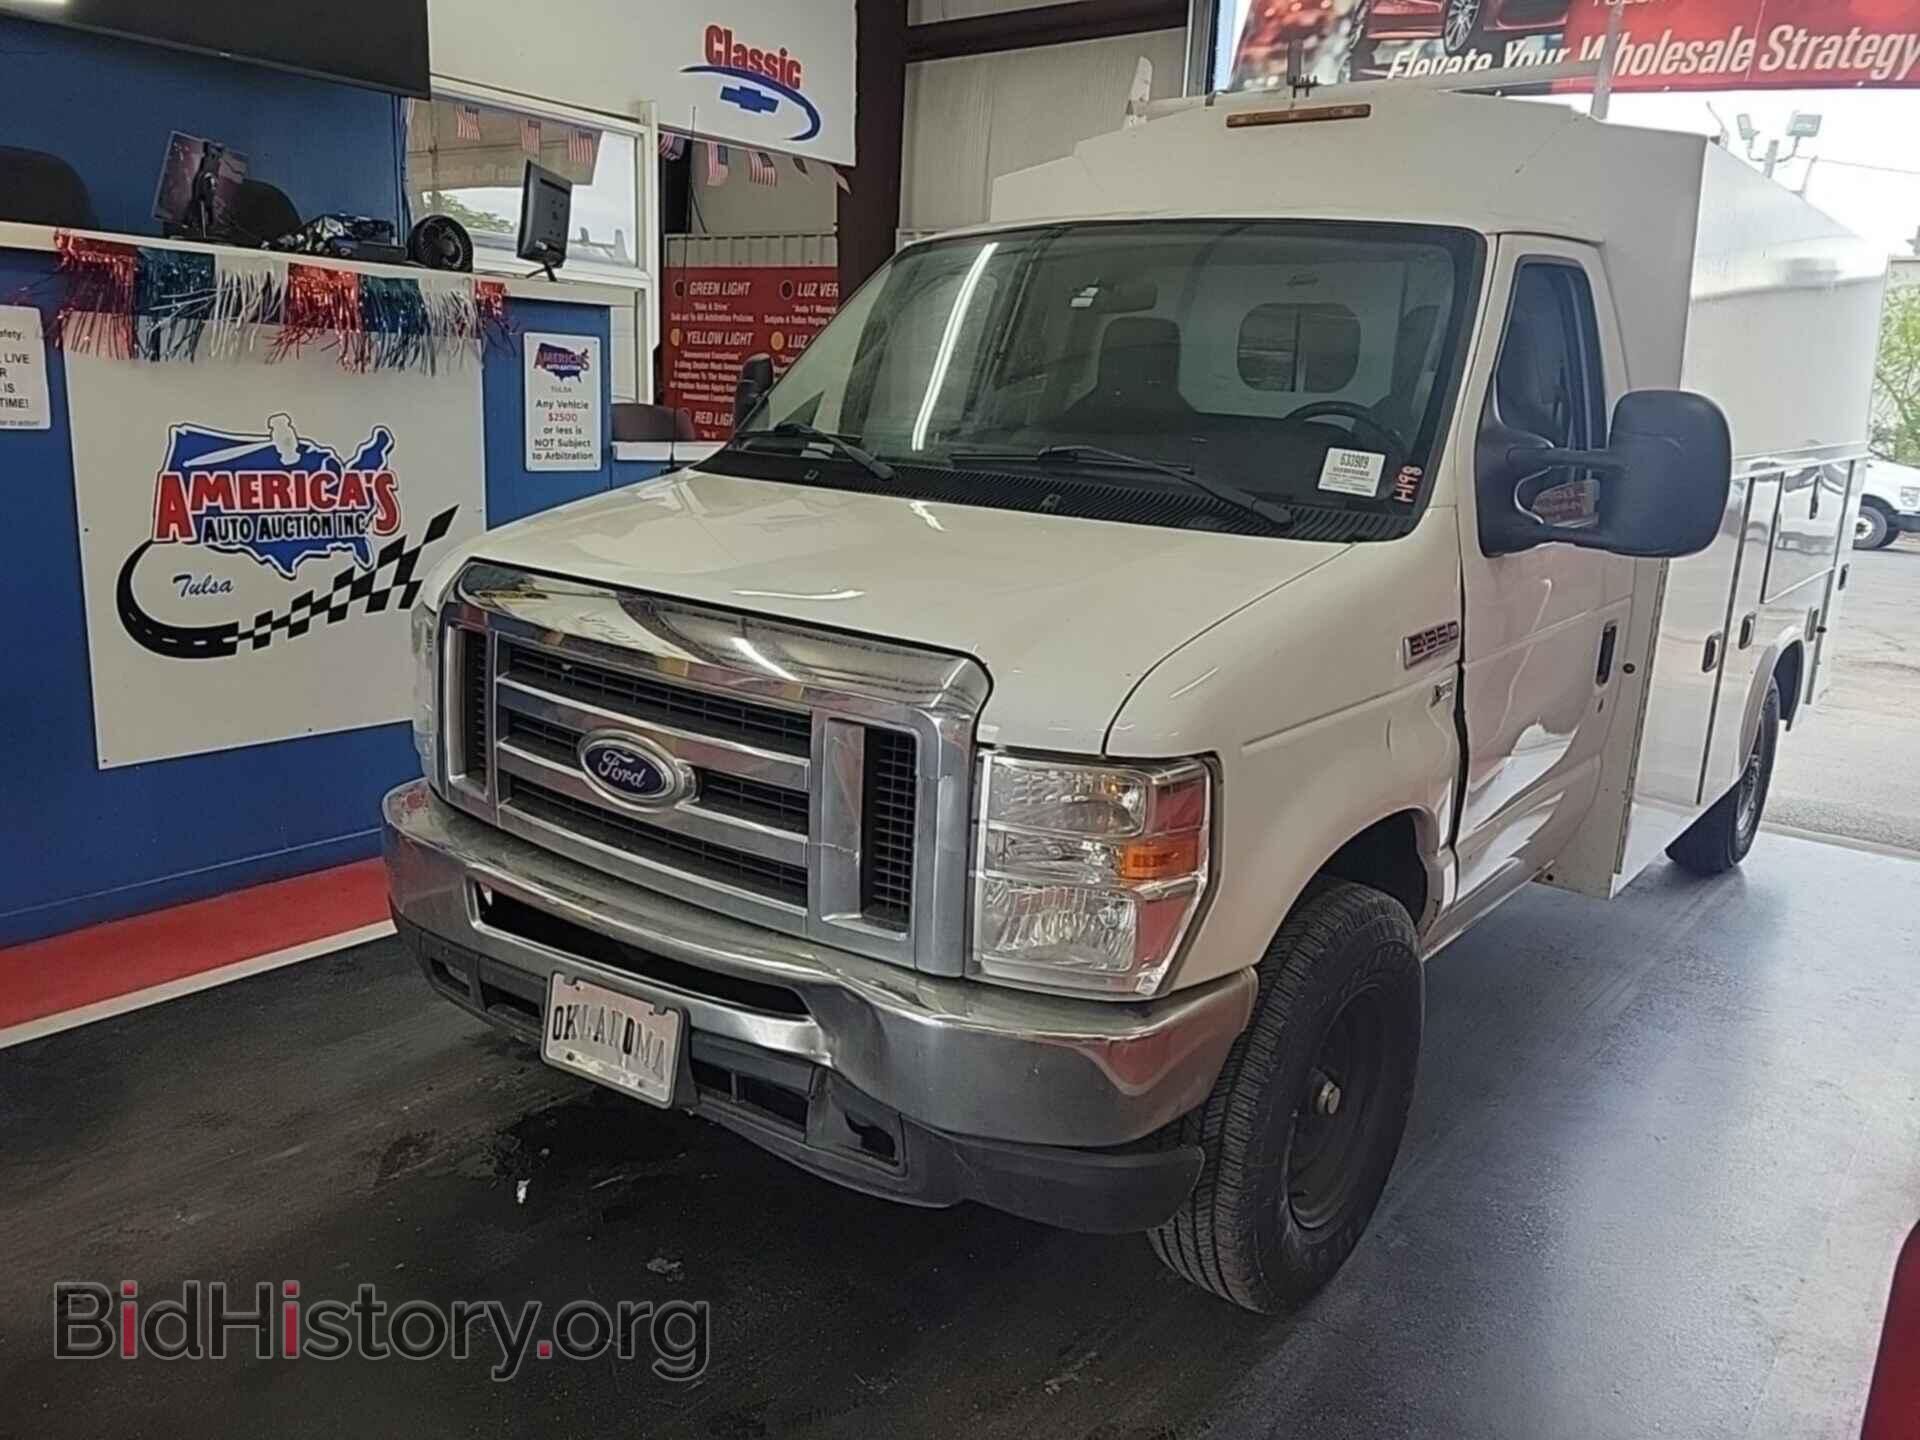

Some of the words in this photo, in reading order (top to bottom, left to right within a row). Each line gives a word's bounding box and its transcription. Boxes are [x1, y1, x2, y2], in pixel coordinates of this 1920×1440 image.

[704, 24, 802, 90] Classic
[1387, 46, 1493, 79] Elevate
[1503, 38, 1571, 68] Your
[1758, 25, 1920, 80] Strategy
[689, 282, 721, 295] GREEN
[722, 282, 751, 295] LIGHT
[797, 283, 817, 297] LUZ
[819, 283, 839, 297] VER
[686, 331, 723, 346] YELLOW
[724, 332, 754, 346] LIGHT
[4, 353, 31, 364] LIVE
[4, 383, 15, 393] IS
[536, 400, 554, 410] Any
[556, 400, 589, 409] Vehicle
[548, 413, 577, 422] $2500
[694, 411, 713, 425] RED
[714, 412, 734, 426] LIGH
[543, 427, 553, 435] or
[556, 426, 573, 434] less
[575, 426, 582, 434] is
[535, 438, 554, 448] NOT
[557, 438, 591, 449] Subject
[532, 452, 541, 460] to
[544, 451, 594, 460] Arbitration
[155, 471, 400, 538] AMERICA'S
[203, 518, 250, 542] AUTO
[258, 515, 333, 540] AUCTION
[173, 574, 234, 598] Tulsa
[598, 749, 647, 788] Ford
